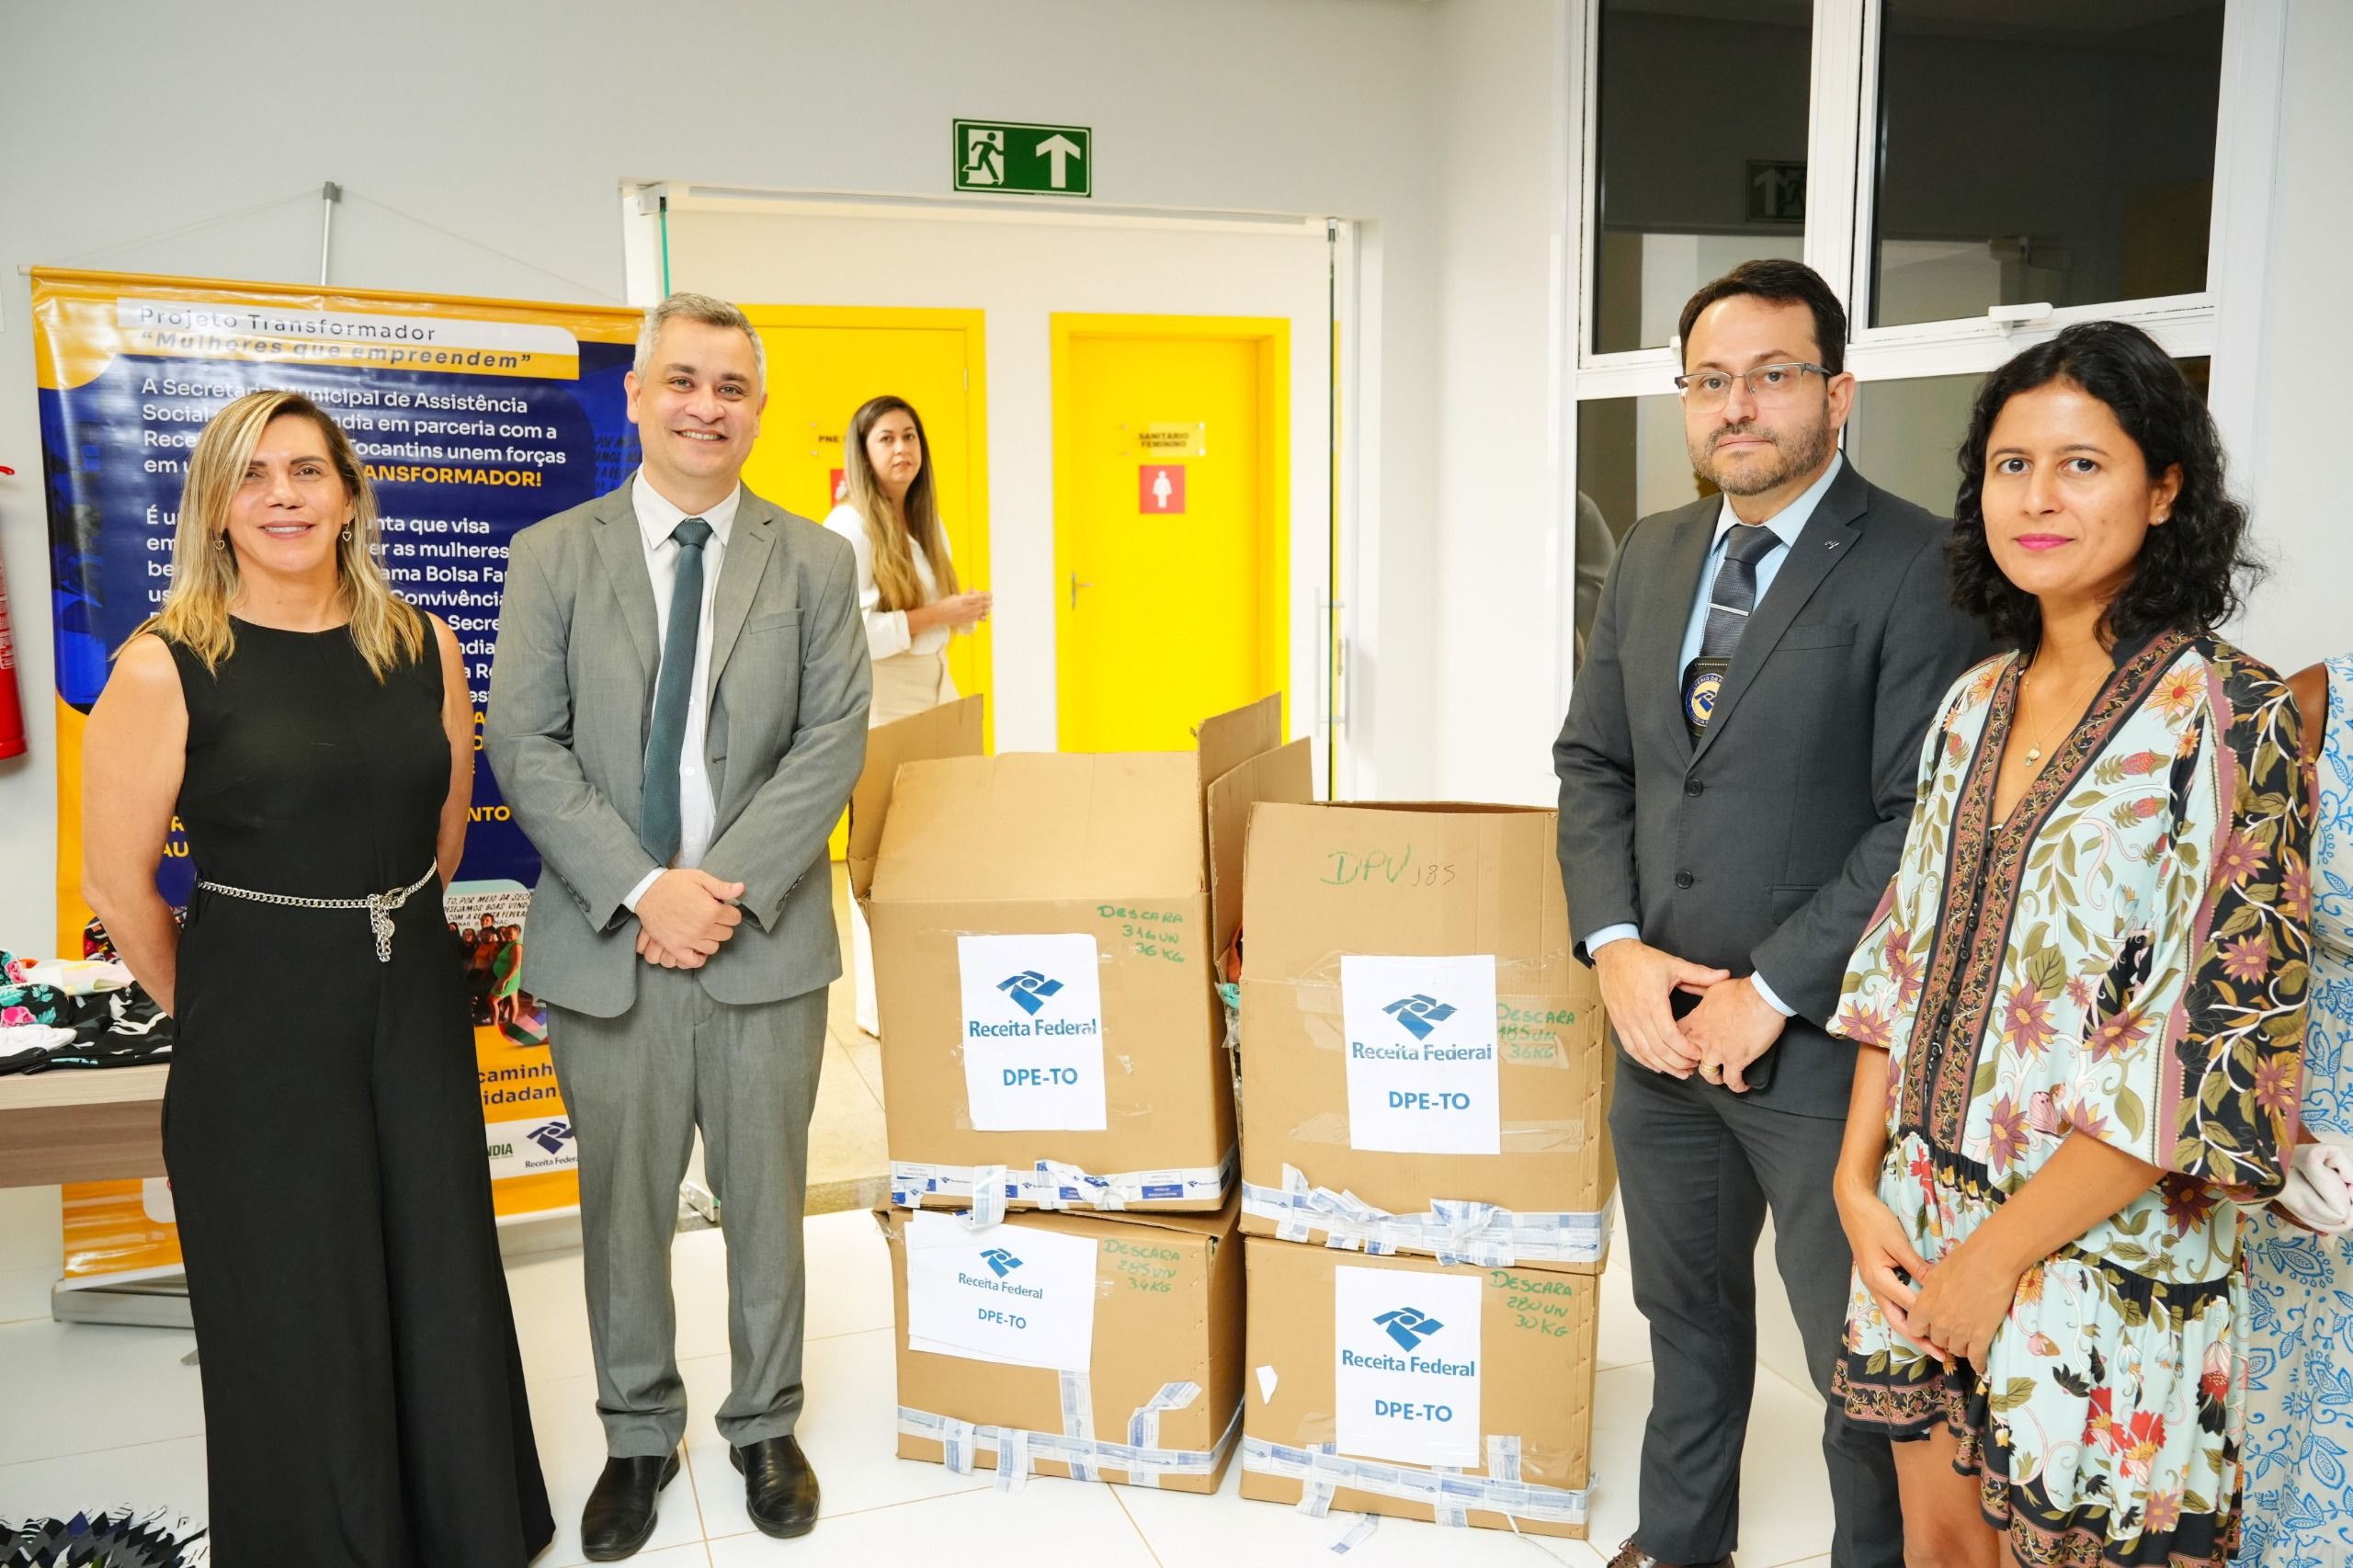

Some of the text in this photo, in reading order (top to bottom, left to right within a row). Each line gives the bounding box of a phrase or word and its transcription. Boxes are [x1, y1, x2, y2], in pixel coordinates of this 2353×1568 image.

[141, 308, 436, 340] Projeto Transformador
[293, 344, 341, 359] que
[142, 378, 158, 394] A
[383, 392, 410, 407] de
[415, 392, 529, 414] Assistência
[142, 404, 209, 422] Social
[378, 419, 409, 432] em
[415, 420, 495, 437] parceria
[499, 425, 542, 438] com
[546, 426, 557, 439] a
[448, 446, 502, 461] unem
[506, 447, 566, 467] forças
[143, 460, 177, 473] em
[364, 464, 542, 487] ANSFORMADOR!
[146, 504, 158, 525] É
[410, 518, 449, 536] que
[451, 517, 490, 534] visa
[392, 543, 415, 557] as
[419, 541, 509, 559] mulheres
[426, 565, 479, 583] Bolsa
[969, 1018, 1097, 1037] Receita Federal
[1352, 1041, 1419, 1061] Receita
[1003, 1067, 1078, 1086] DPE-TO
[1389, 1091, 1471, 1110] DPE-TO
[525, 1157, 553, 1168] Receita
[958, 1272, 1043, 1300] Receita Federal
[978, 1308, 1027, 1329] DPE-TO
[1342, 1349, 1475, 1377] Receita Federal
[1375, 1399, 1453, 1423] DPE-TO
